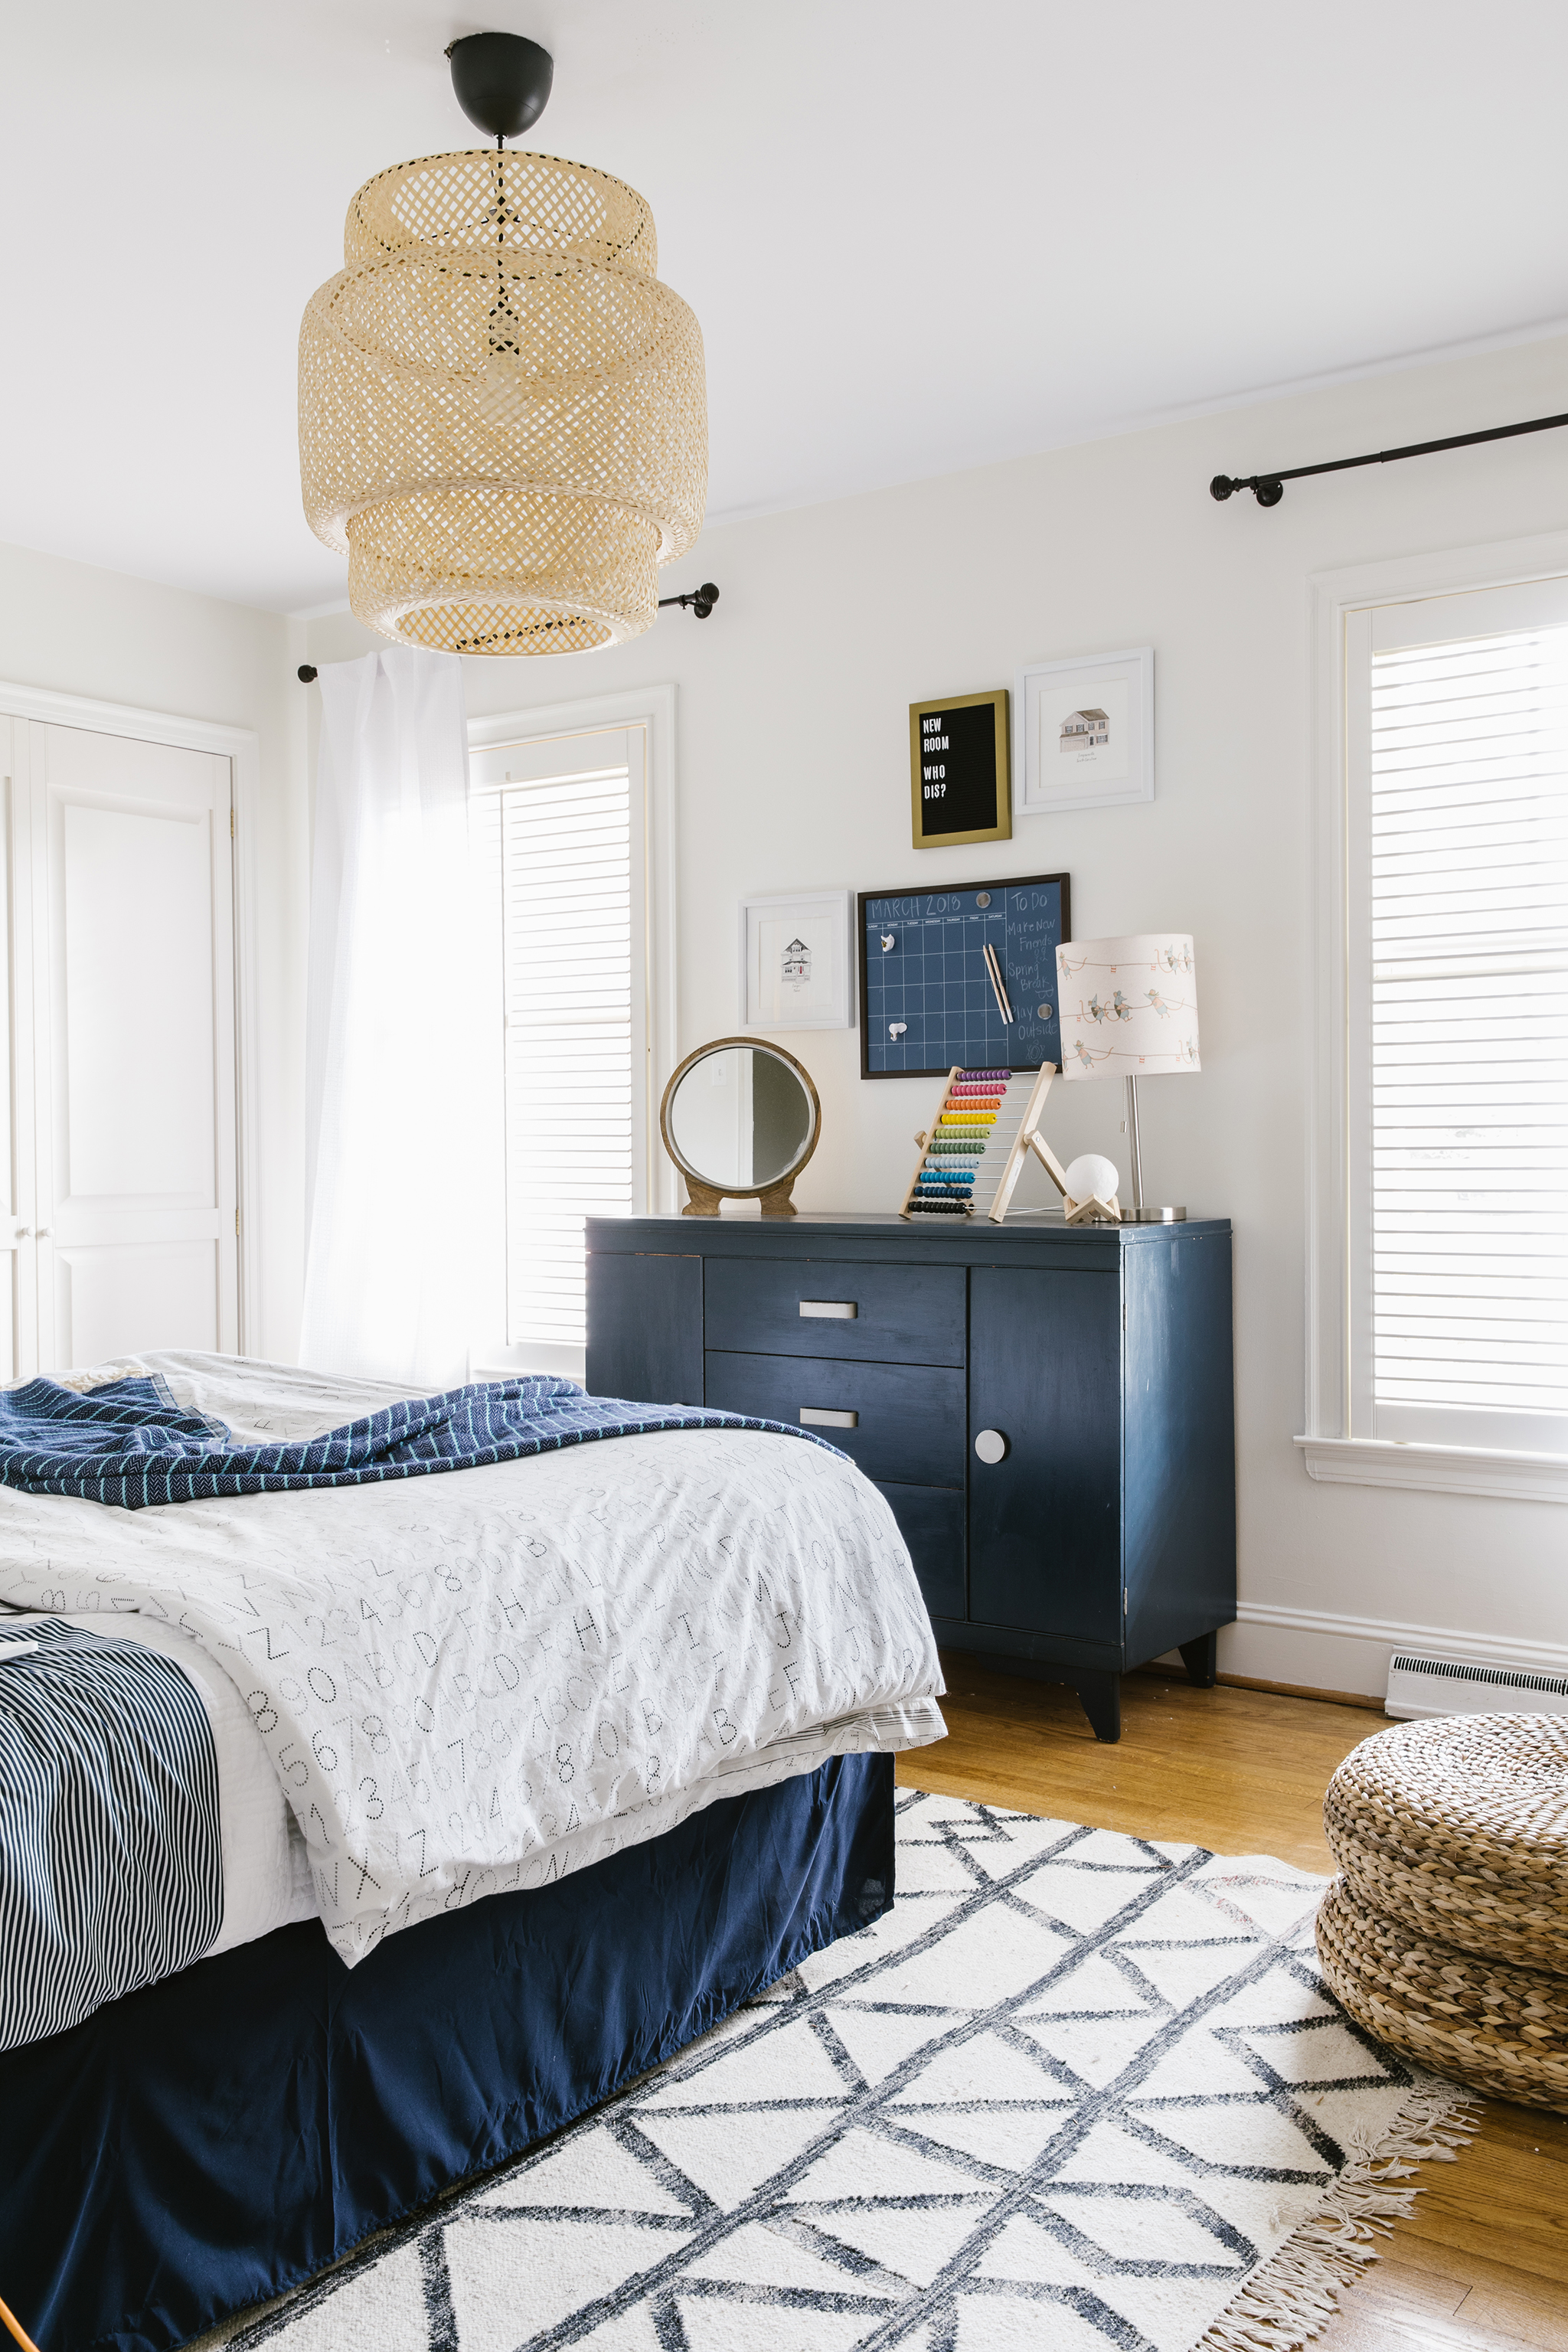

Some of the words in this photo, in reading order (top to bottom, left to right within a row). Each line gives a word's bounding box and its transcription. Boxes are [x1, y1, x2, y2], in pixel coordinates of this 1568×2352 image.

[923, 717, 942, 733] NEW
[923, 736, 949, 753] ROOM
[923, 764, 946, 780] WHO
[924, 783, 946, 799] DIS?
[871, 897, 921, 919] MARCH
[1011, 891, 1027, 911] To
[1031, 892, 1047, 910] Do
[1008, 922, 1034, 936] Make
[1019, 934, 1053, 952] Friends
[1008, 962, 1039, 980] Spring
[1021, 976, 1050, 992] Break
[1018, 1019, 1058, 1040] Outside
